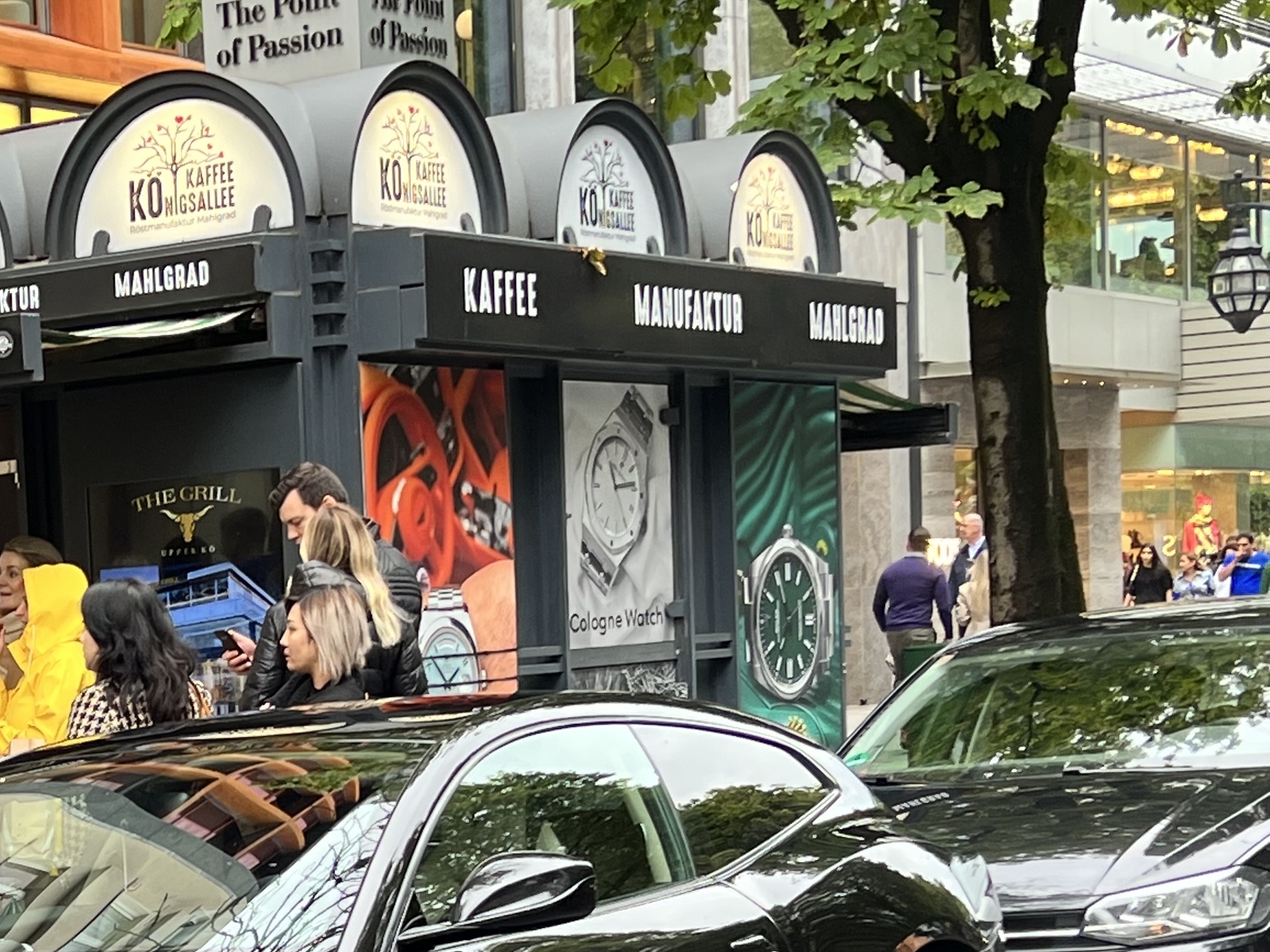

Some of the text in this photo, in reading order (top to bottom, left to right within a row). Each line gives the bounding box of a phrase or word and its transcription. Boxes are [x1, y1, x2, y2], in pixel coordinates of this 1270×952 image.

[216, 1, 266, 30] The
[217, 24, 344, 68] of Passion
[370, 19, 447, 58] of Passion
[186, 161, 234, 189] KAFFEE
[416, 159, 445, 184] KAFFEE
[114, 259, 210, 298] MAHLGRAD
[463, 267, 884, 345] KAFFEE MANUFAKTUR MAHLGRAD
[131, 485, 242, 513] THE GRILL
[570, 605, 664, 636] Cologne Watch
